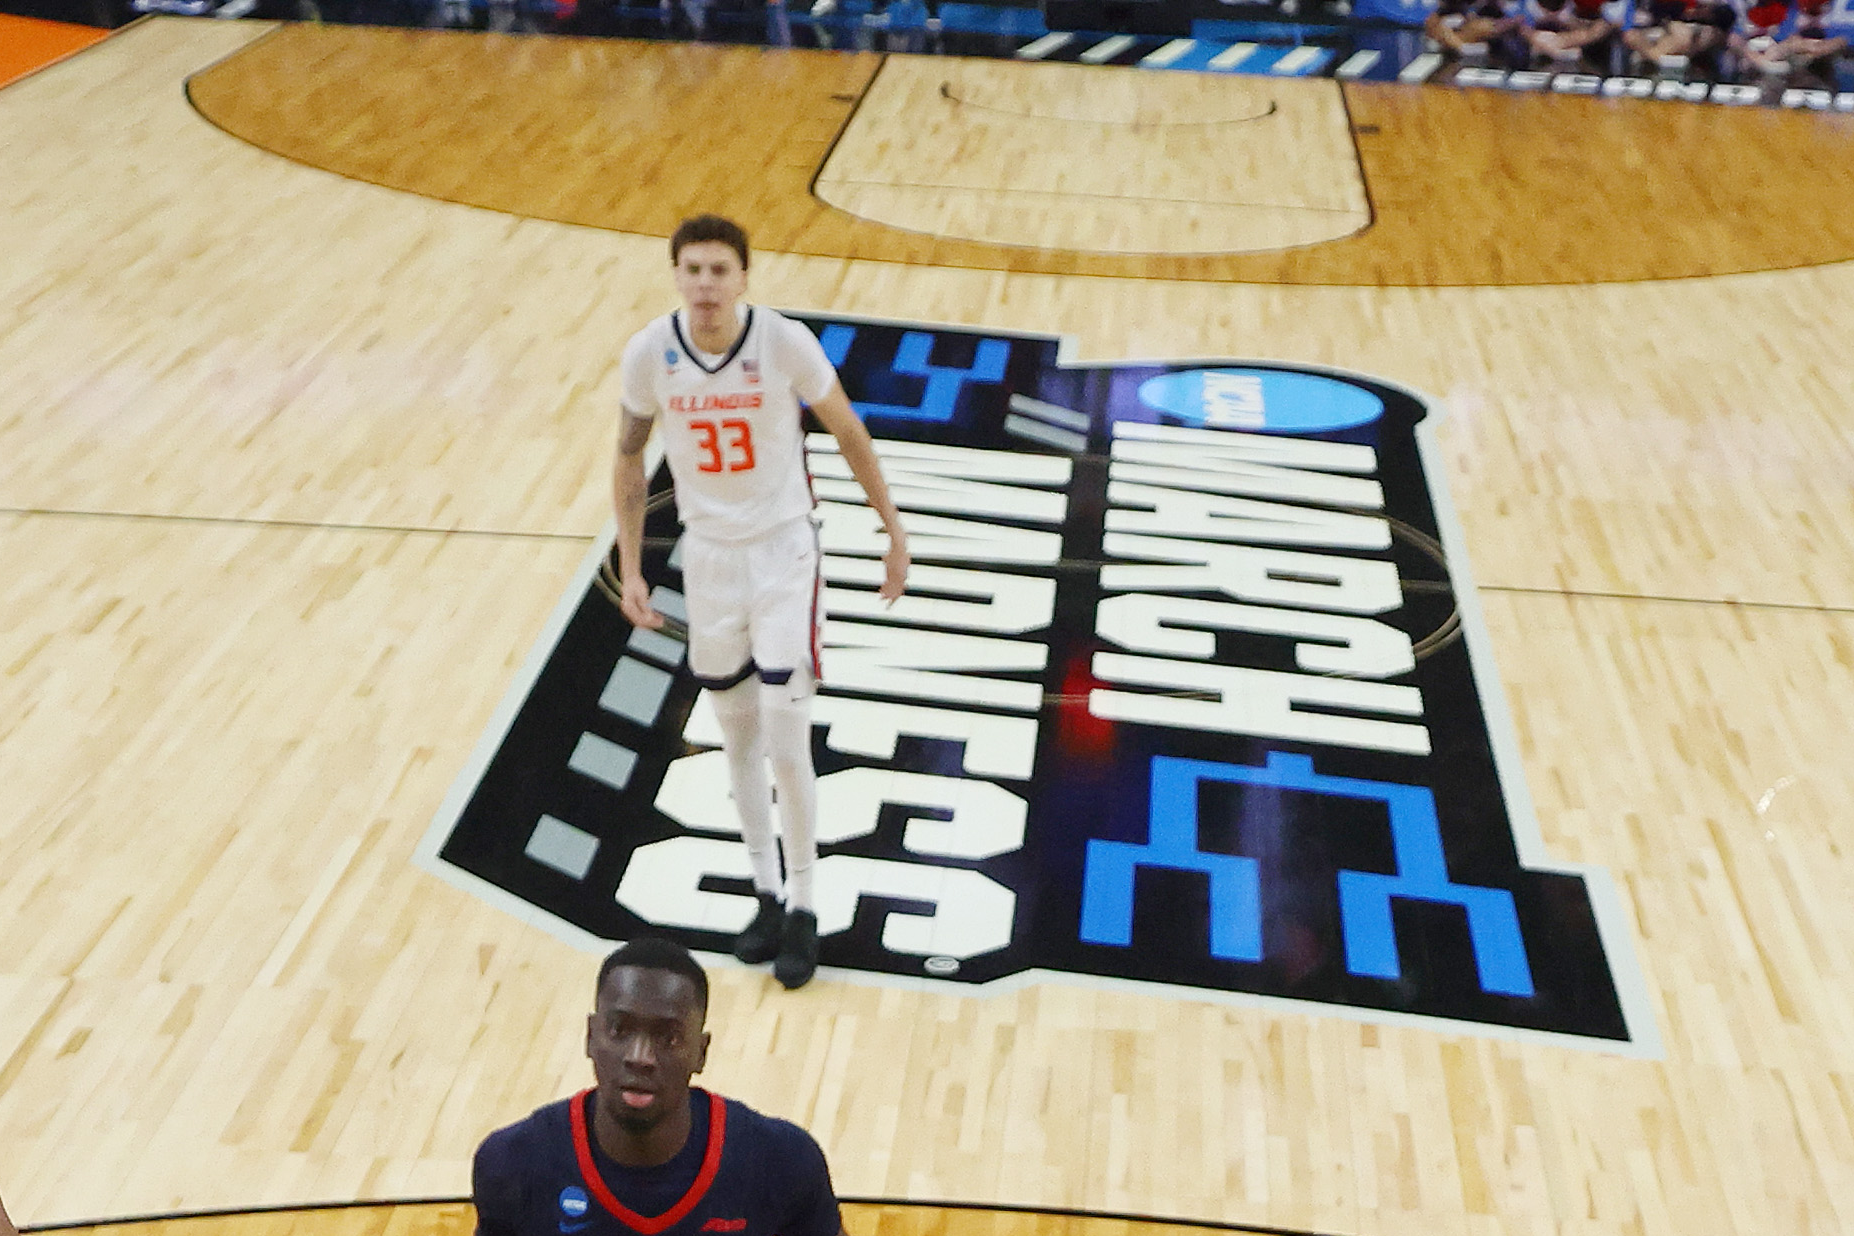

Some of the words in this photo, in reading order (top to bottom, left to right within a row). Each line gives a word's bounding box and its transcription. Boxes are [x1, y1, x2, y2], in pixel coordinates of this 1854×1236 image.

[669, 392, 764, 412] ILLINOIS
[689, 417, 757, 473] 33
[1087, 420, 1432, 757] MARCH
[615, 432, 1074, 960] MADNESS
